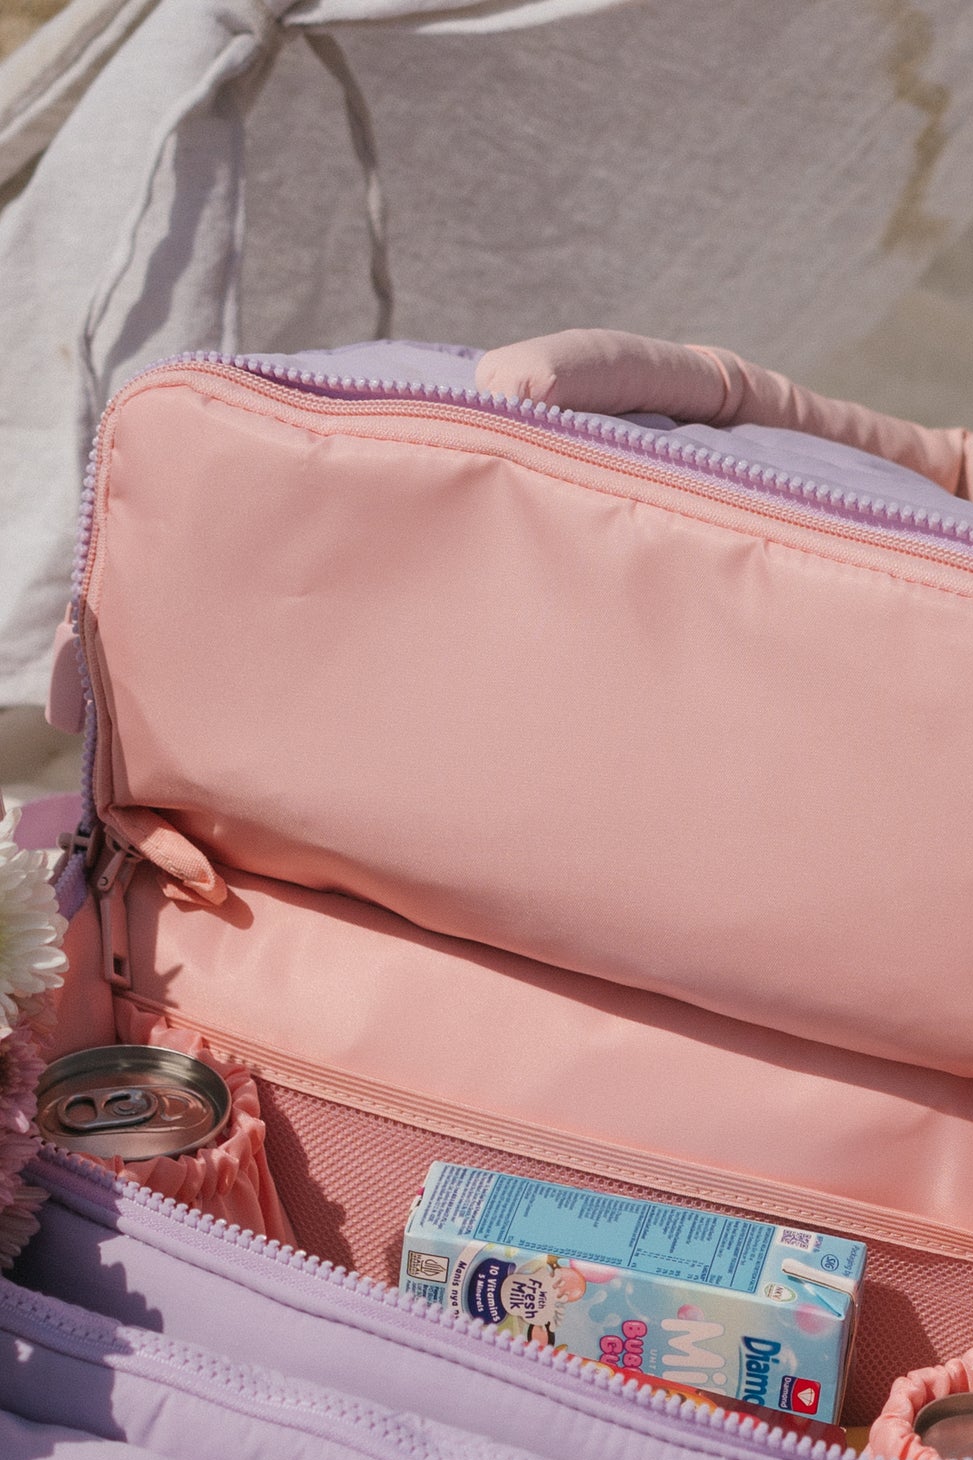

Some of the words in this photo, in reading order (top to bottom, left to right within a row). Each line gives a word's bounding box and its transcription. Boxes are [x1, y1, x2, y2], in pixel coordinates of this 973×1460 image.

[451, 1261, 467, 1287] Manis
[489, 1265, 500, 1276] 10
[450, 1289, 459, 1307] nya
[475, 1281, 485, 1312] Minerals
[487, 1278, 501, 1321] Vitamins
[510, 1281, 526, 1310] Milk
[525, 1278, 543, 1319] Fresh
[538, 1291, 548, 1310] With
[661, 1318, 727, 1396] Mi
[780, 1378, 792, 1409] Diamond
